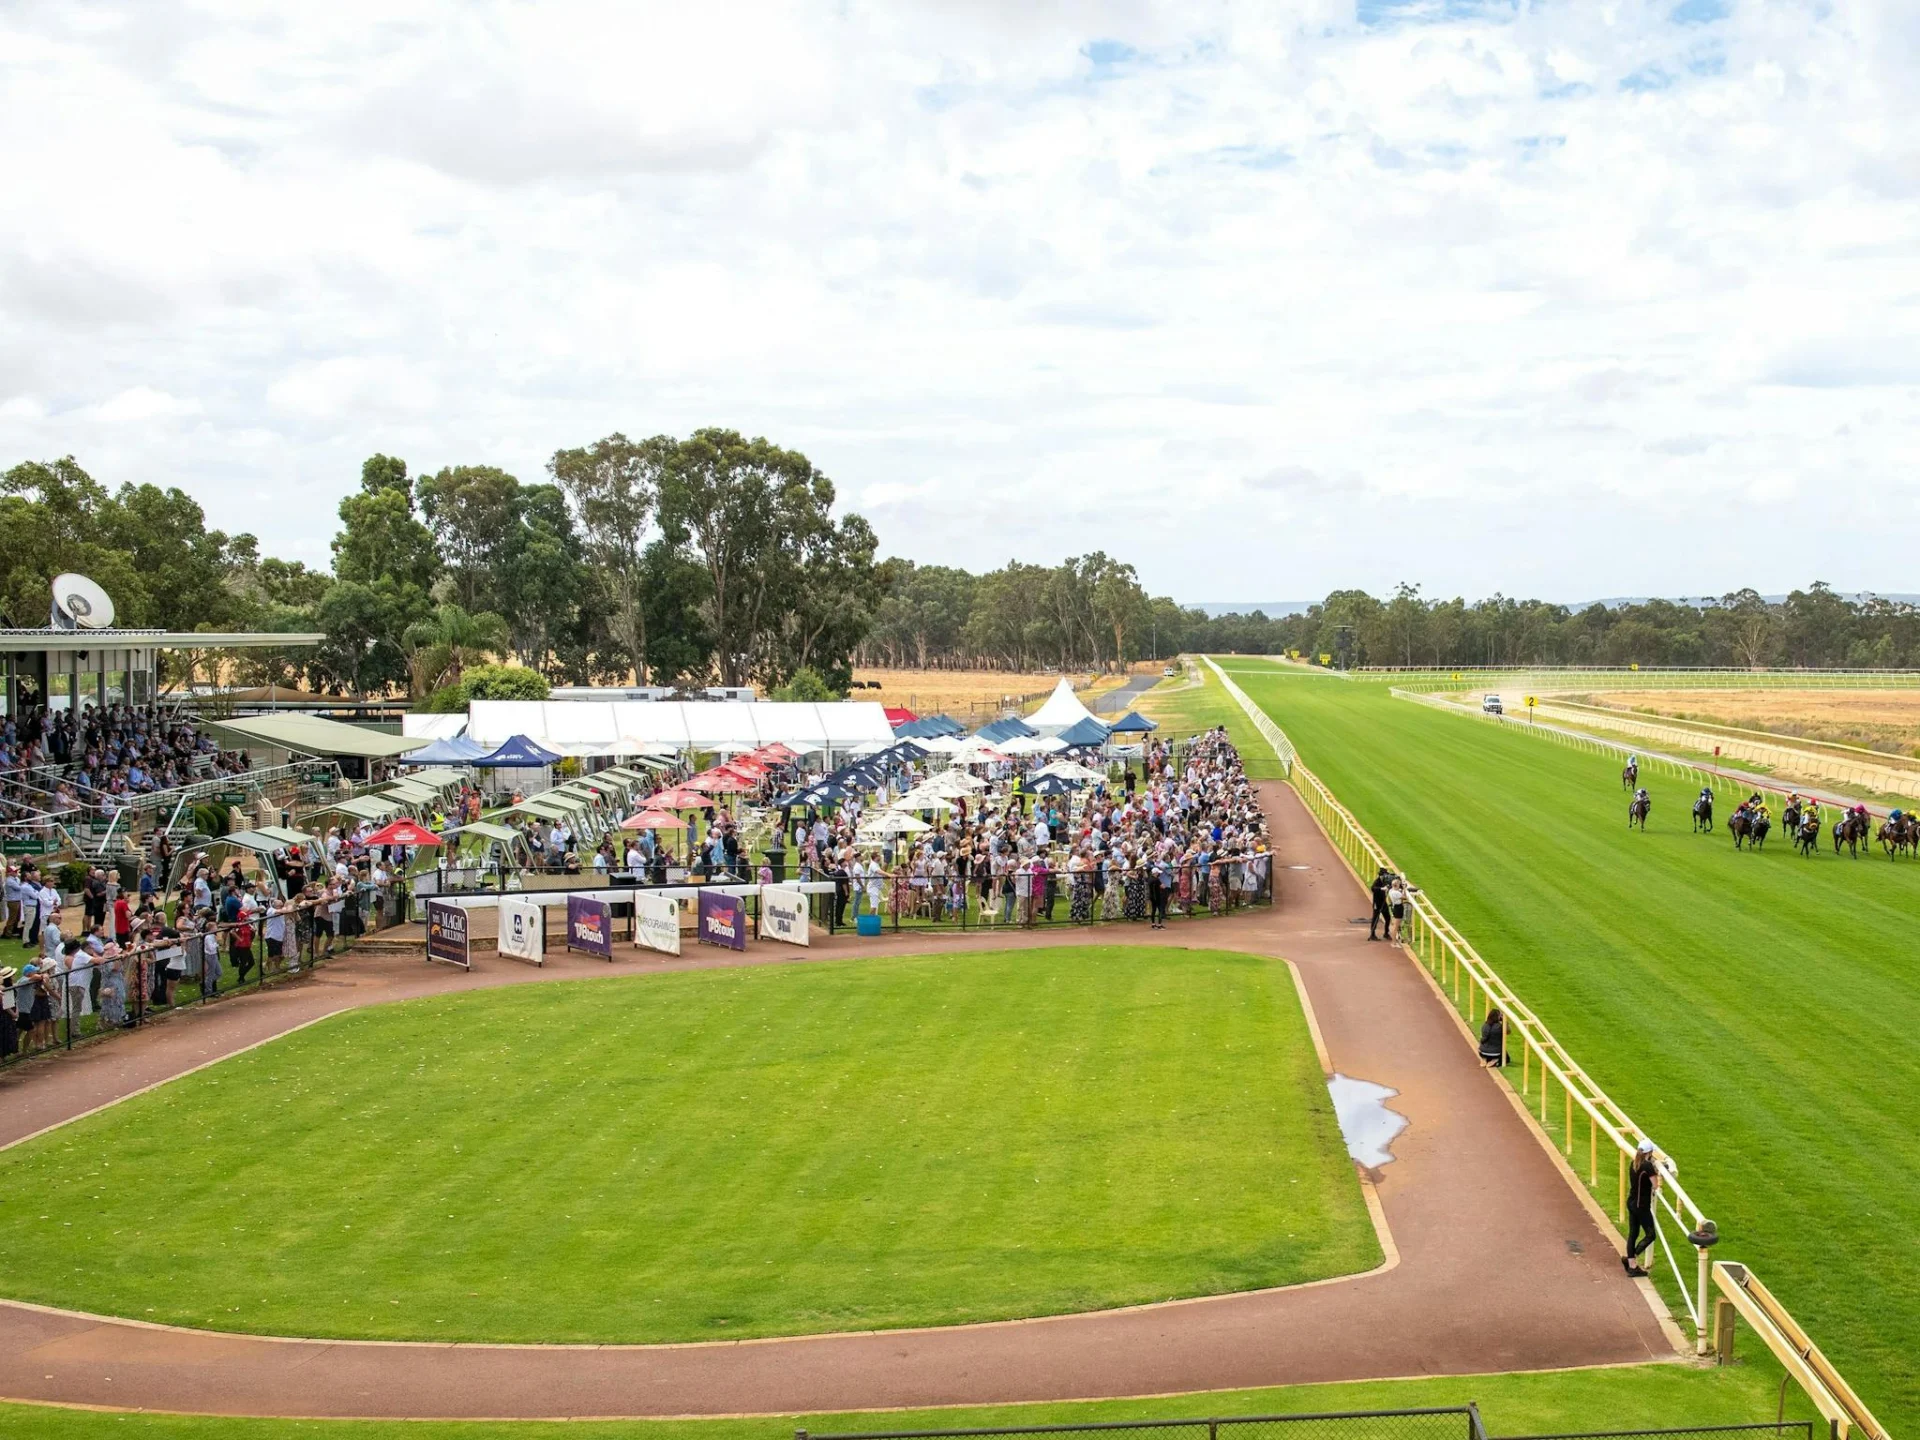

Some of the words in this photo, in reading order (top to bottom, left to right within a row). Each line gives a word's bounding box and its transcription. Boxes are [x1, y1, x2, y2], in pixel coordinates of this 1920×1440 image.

[1528, 696, 1534, 706] 2
[524, 896, 529, 904] 2
[441, 911, 466, 932] MAGIC
[441, 928, 466, 944] MILLIONS
